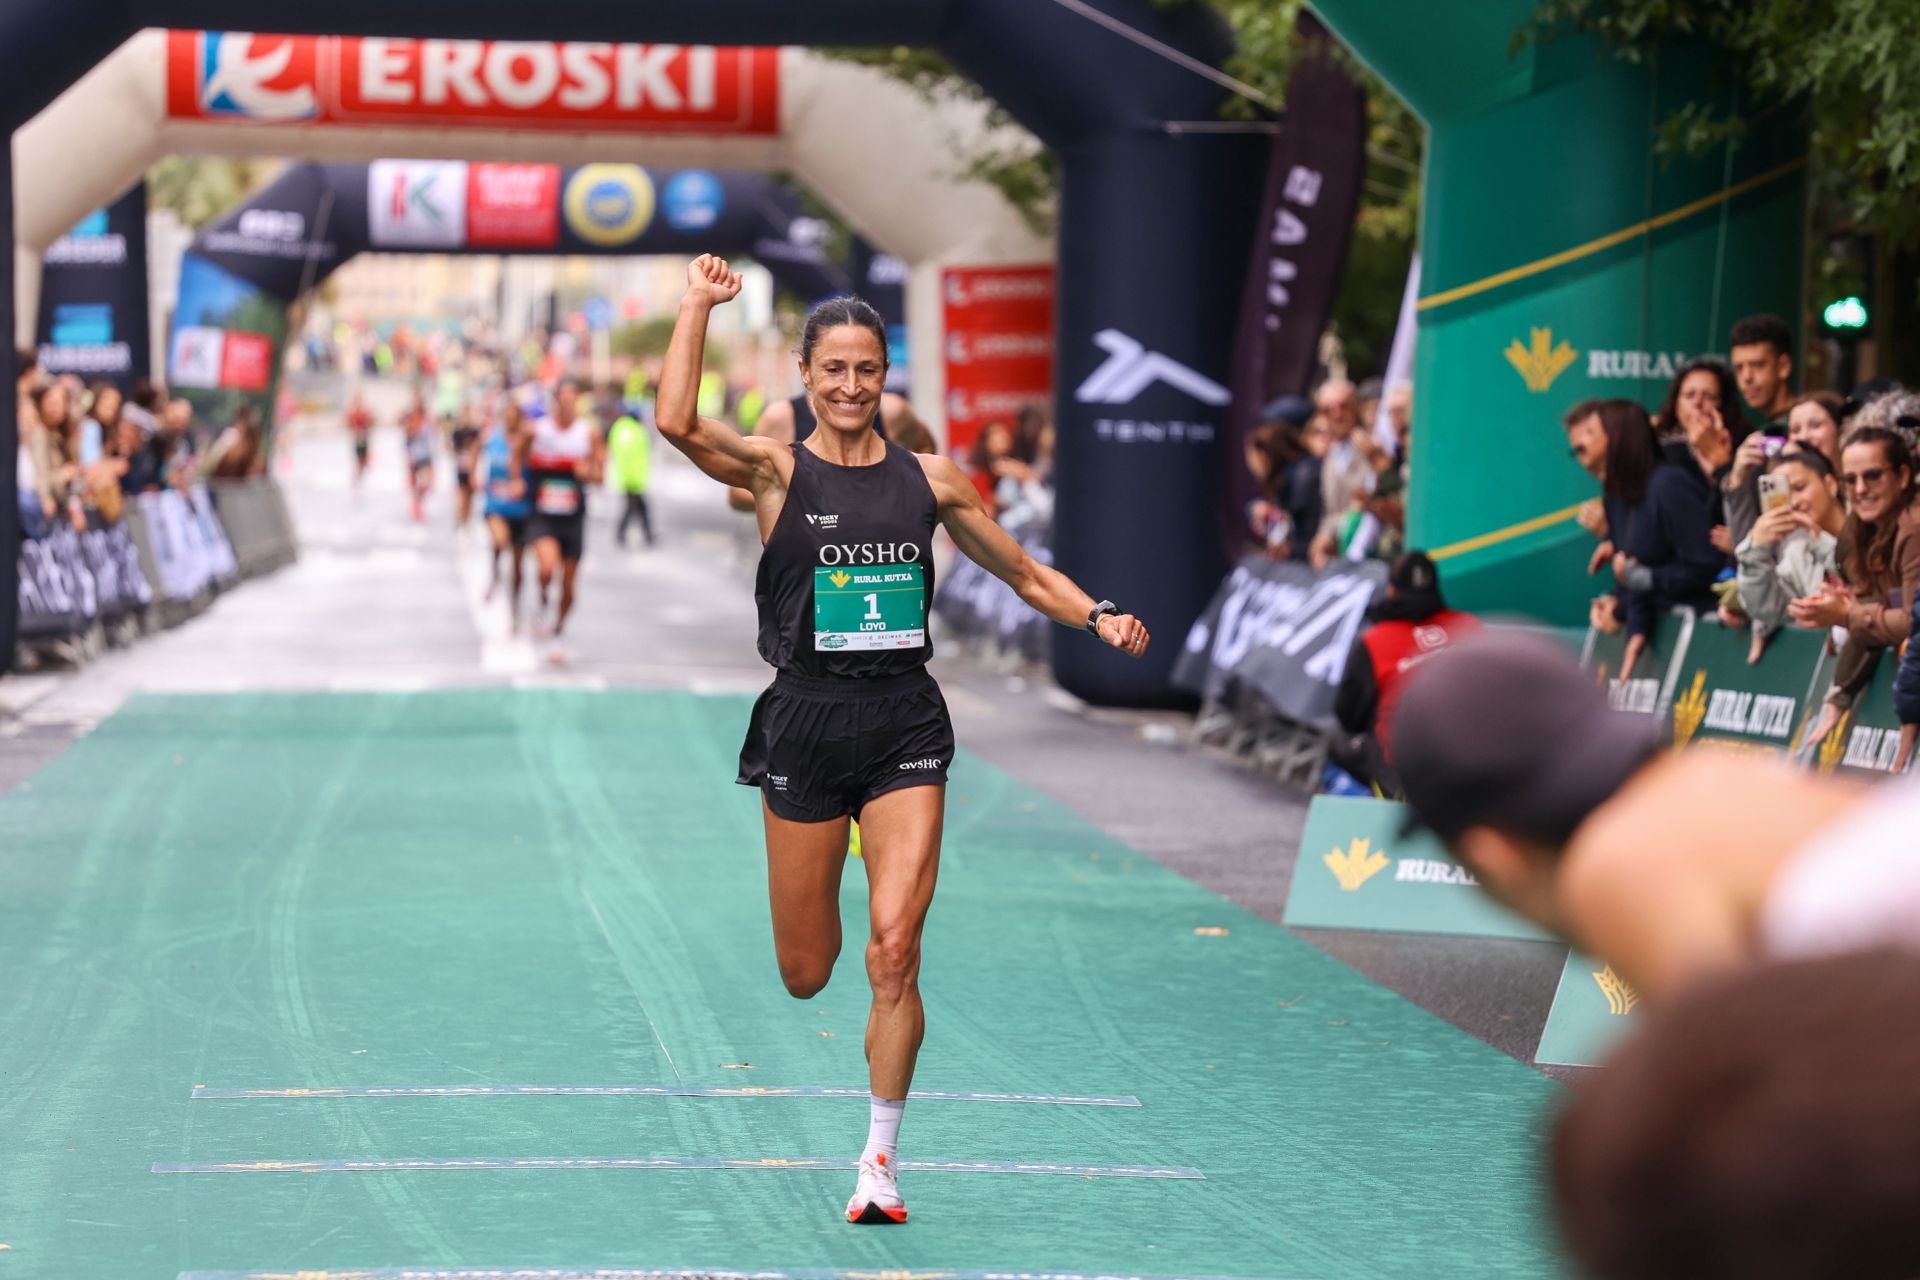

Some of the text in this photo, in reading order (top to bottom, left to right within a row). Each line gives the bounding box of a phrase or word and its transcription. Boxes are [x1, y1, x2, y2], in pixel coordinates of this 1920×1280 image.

[360, 36, 716, 112] EROSKI
[1095, 419, 1214, 442] TENTH
[819, 542, 920, 566] OYSHO
[853, 572, 913, 584] RURAL KUTXA
[863, 593, 881, 620] 1
[860, 622, 886, 631] LOYO
[899, 758, 942, 770] OYSHO
